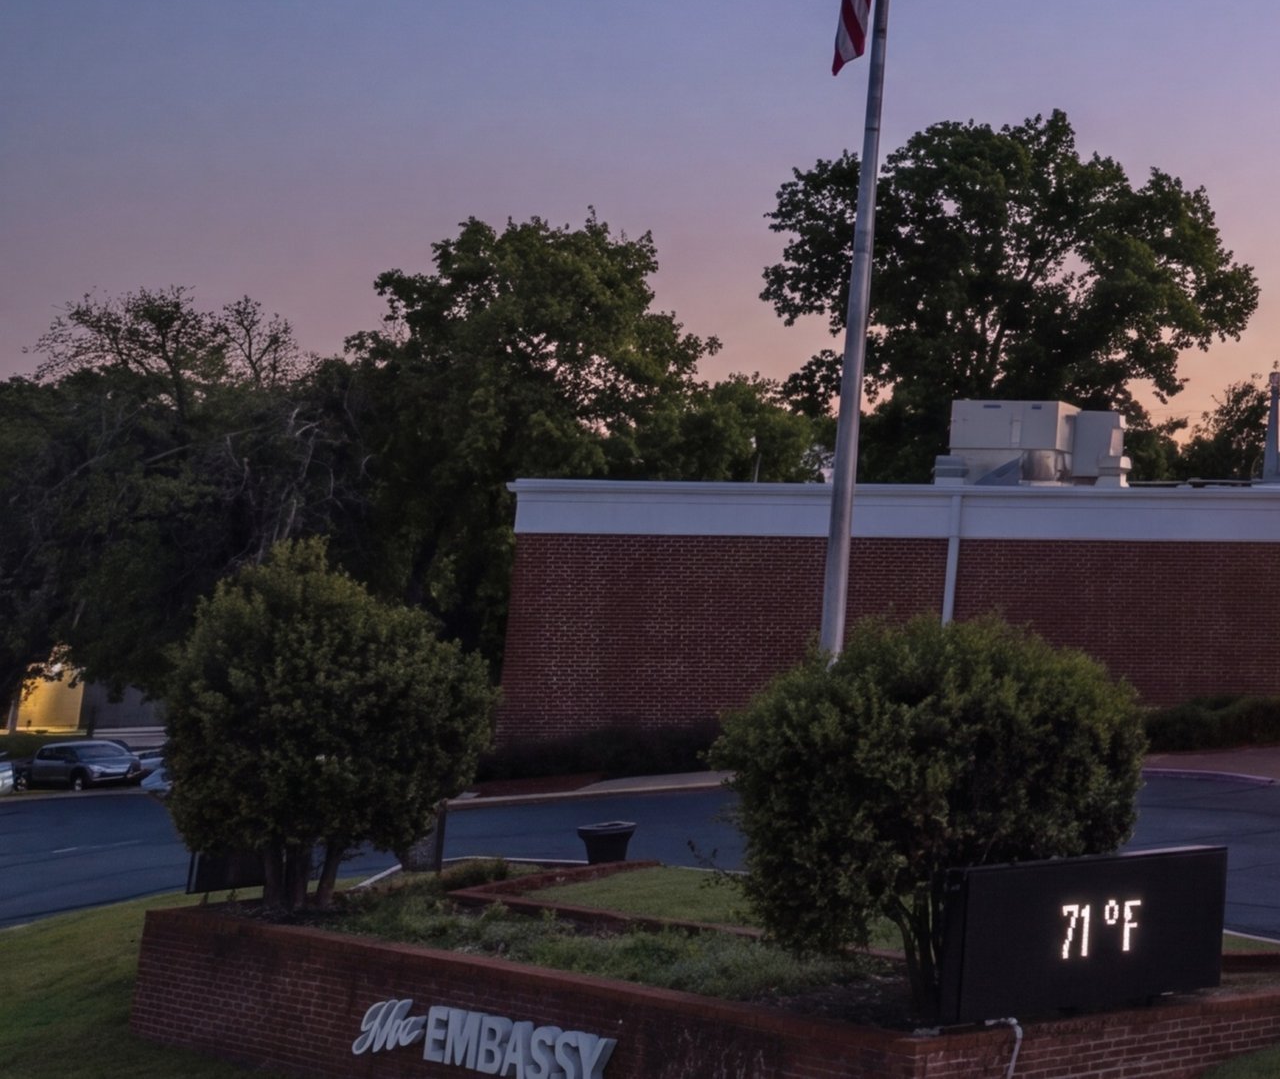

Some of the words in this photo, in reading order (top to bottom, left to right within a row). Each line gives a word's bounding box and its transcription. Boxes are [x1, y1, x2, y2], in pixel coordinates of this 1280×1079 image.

[1062, 904, 1090, 959] 71
[352, 999, 427, 1055] The
[423, 1006, 618, 1079] EMBASSY
